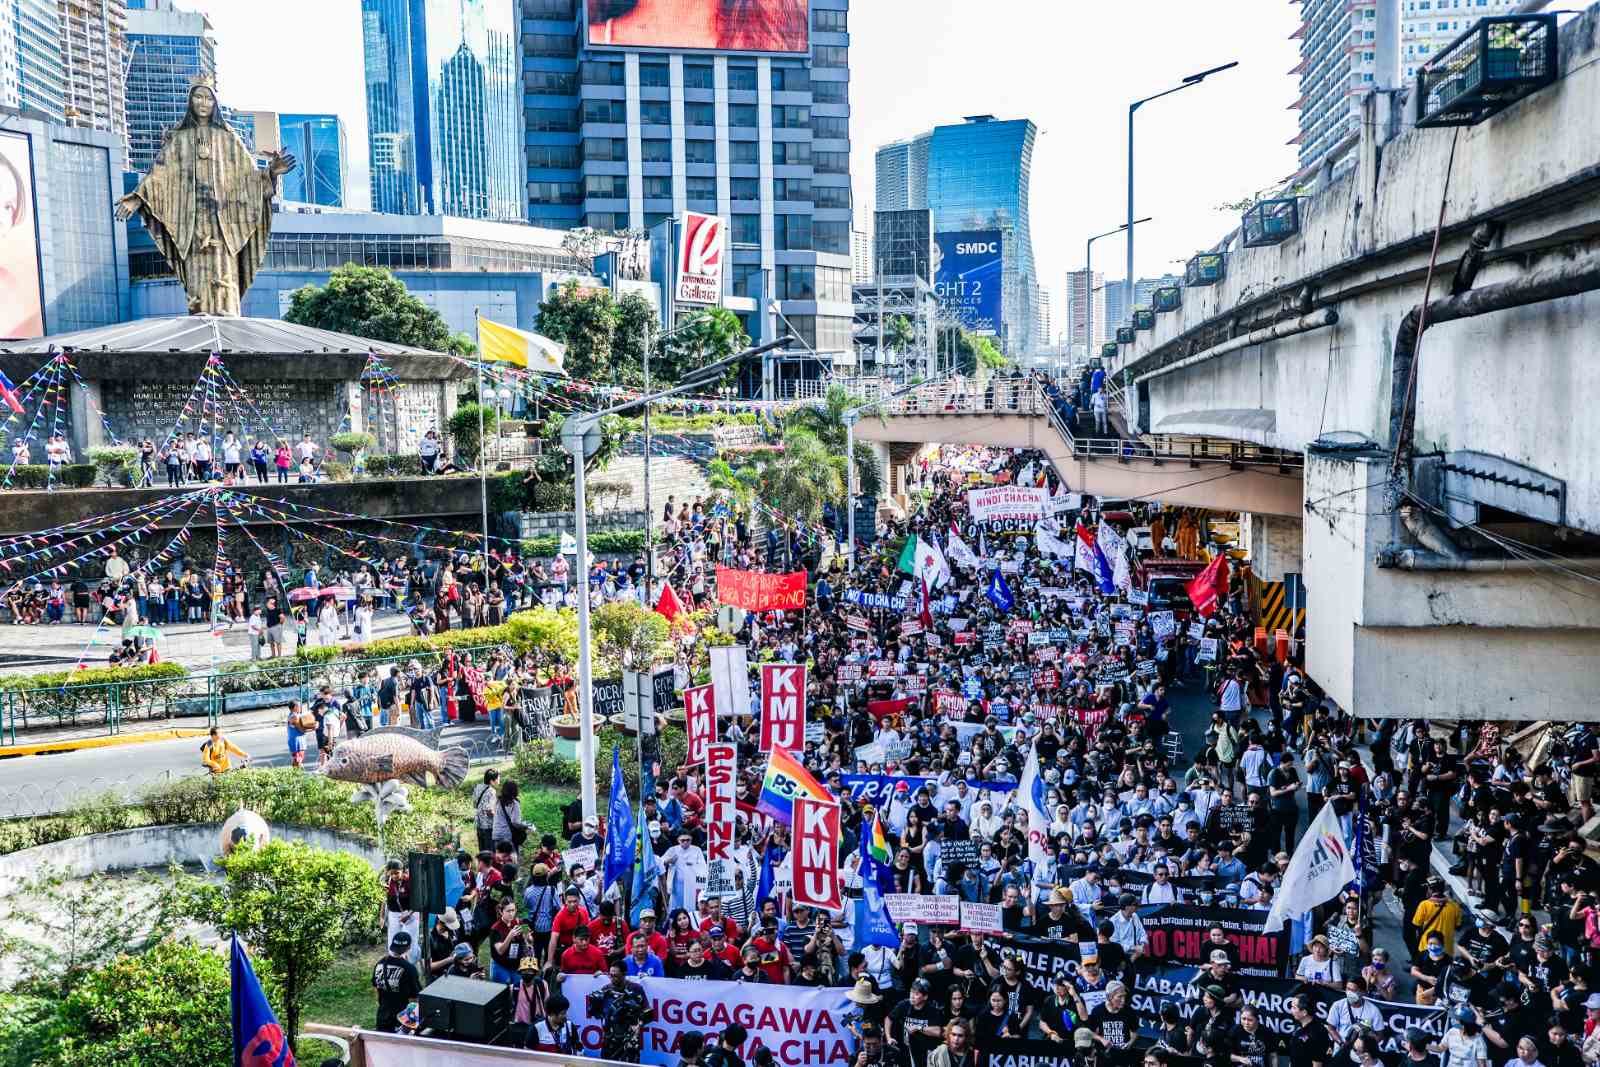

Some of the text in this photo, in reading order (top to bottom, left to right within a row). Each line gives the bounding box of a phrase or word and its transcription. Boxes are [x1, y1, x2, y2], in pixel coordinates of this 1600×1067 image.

[956, 242, 998, 254] SMDC
[933, 281, 982, 296] GHT 2
[770, 668, 797, 748] KMU
[691, 689, 710, 761] KMU
[848, 780, 894, 802] TRA
[707, 746, 735, 860] PSLINK
[801, 803, 833, 903] KMU
[1052, 956, 1080, 977] PO
[1134, 974, 1200, 1000] LABAN
[1131, 994, 1156, 1014] SA
[988, 1053, 1075, 1067] KABUHA
